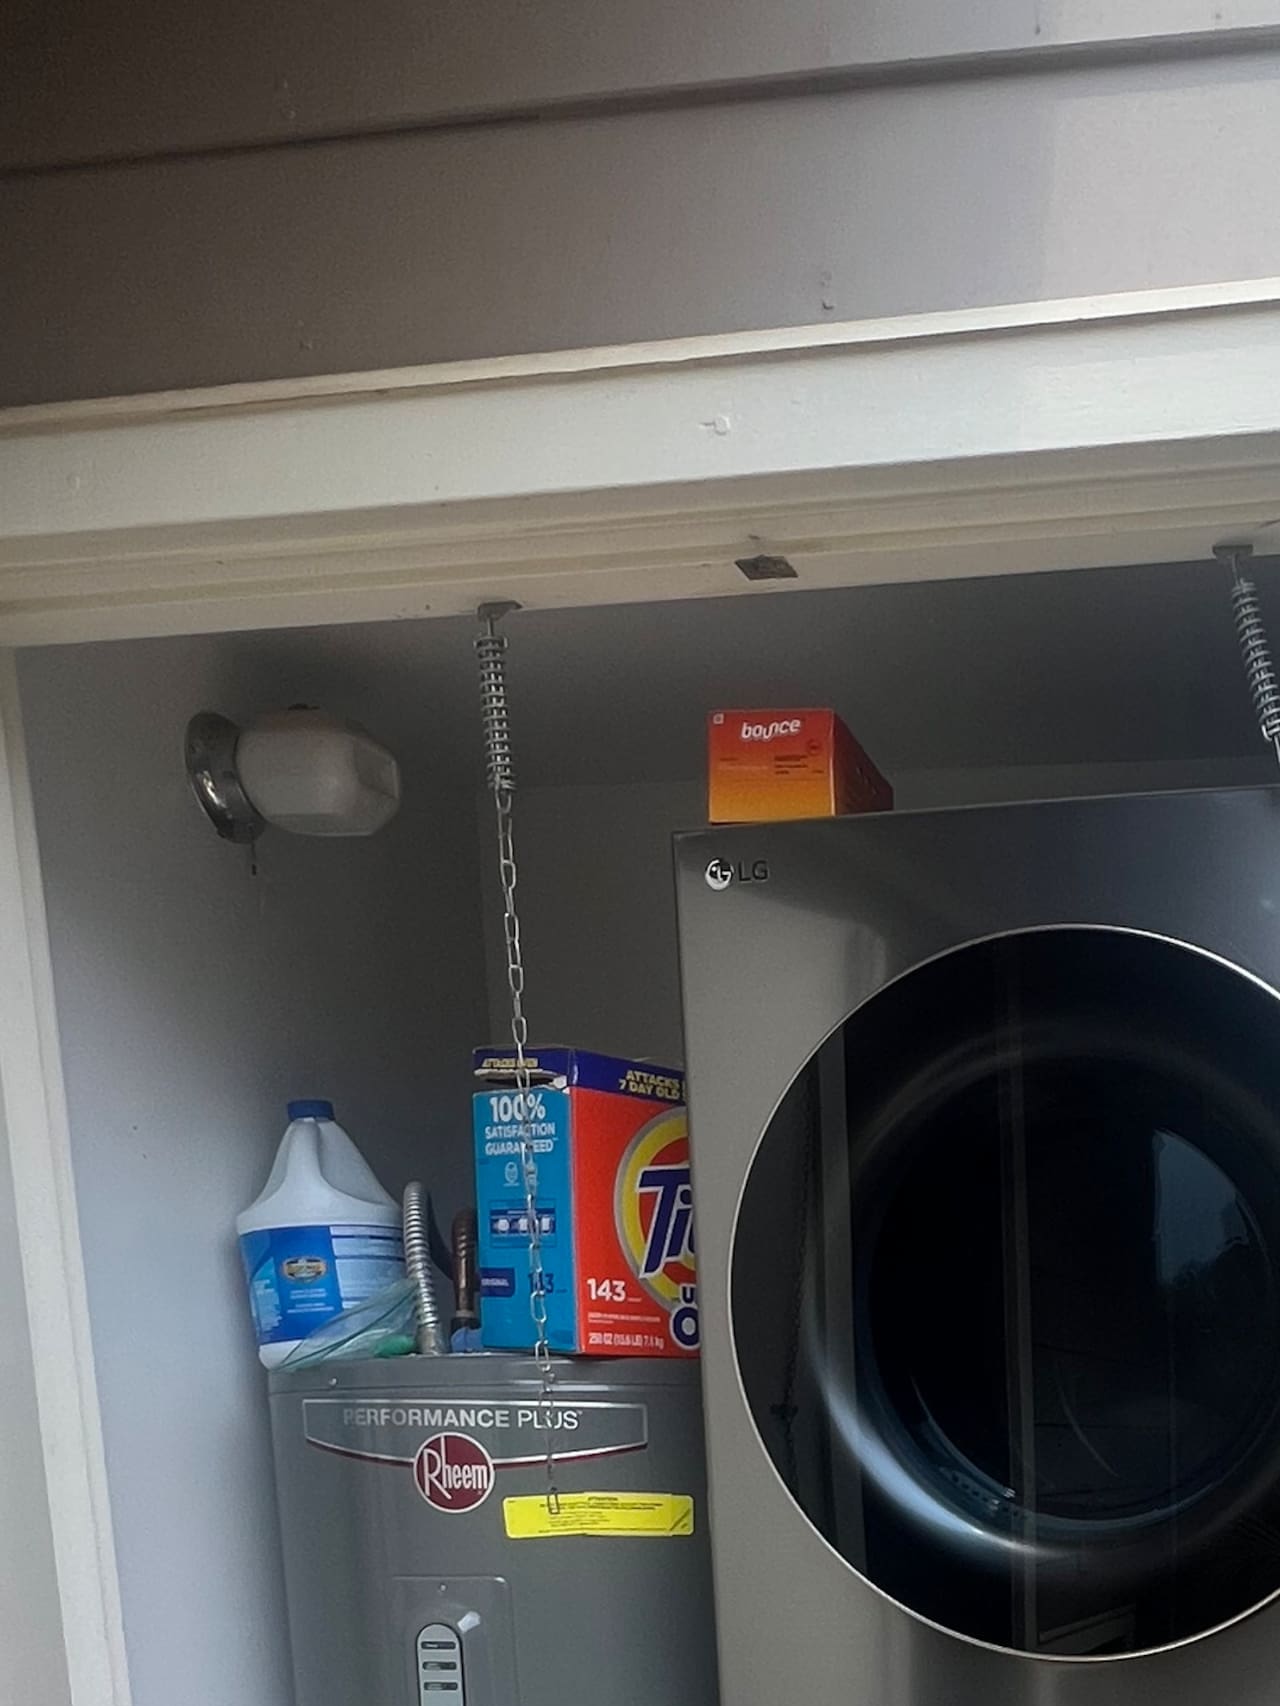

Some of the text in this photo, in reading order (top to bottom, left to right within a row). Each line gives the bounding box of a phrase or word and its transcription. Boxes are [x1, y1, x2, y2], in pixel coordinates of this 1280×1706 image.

[741, 718, 801, 740] bounce
[738, 860, 769, 882] LG
[619, 1078, 680, 1100] 7 DAY OLD
[490, 1093, 546, 1122] 100%
[485, 1139, 554, 1155] GUARAEED
[638, 1167, 698, 1277] Ti
[587, 1278, 626, 1301] 143
[344, 1408, 579, 1429] PERFORMANCE PLUS
[423, 1435, 488, 1499] Rheem
